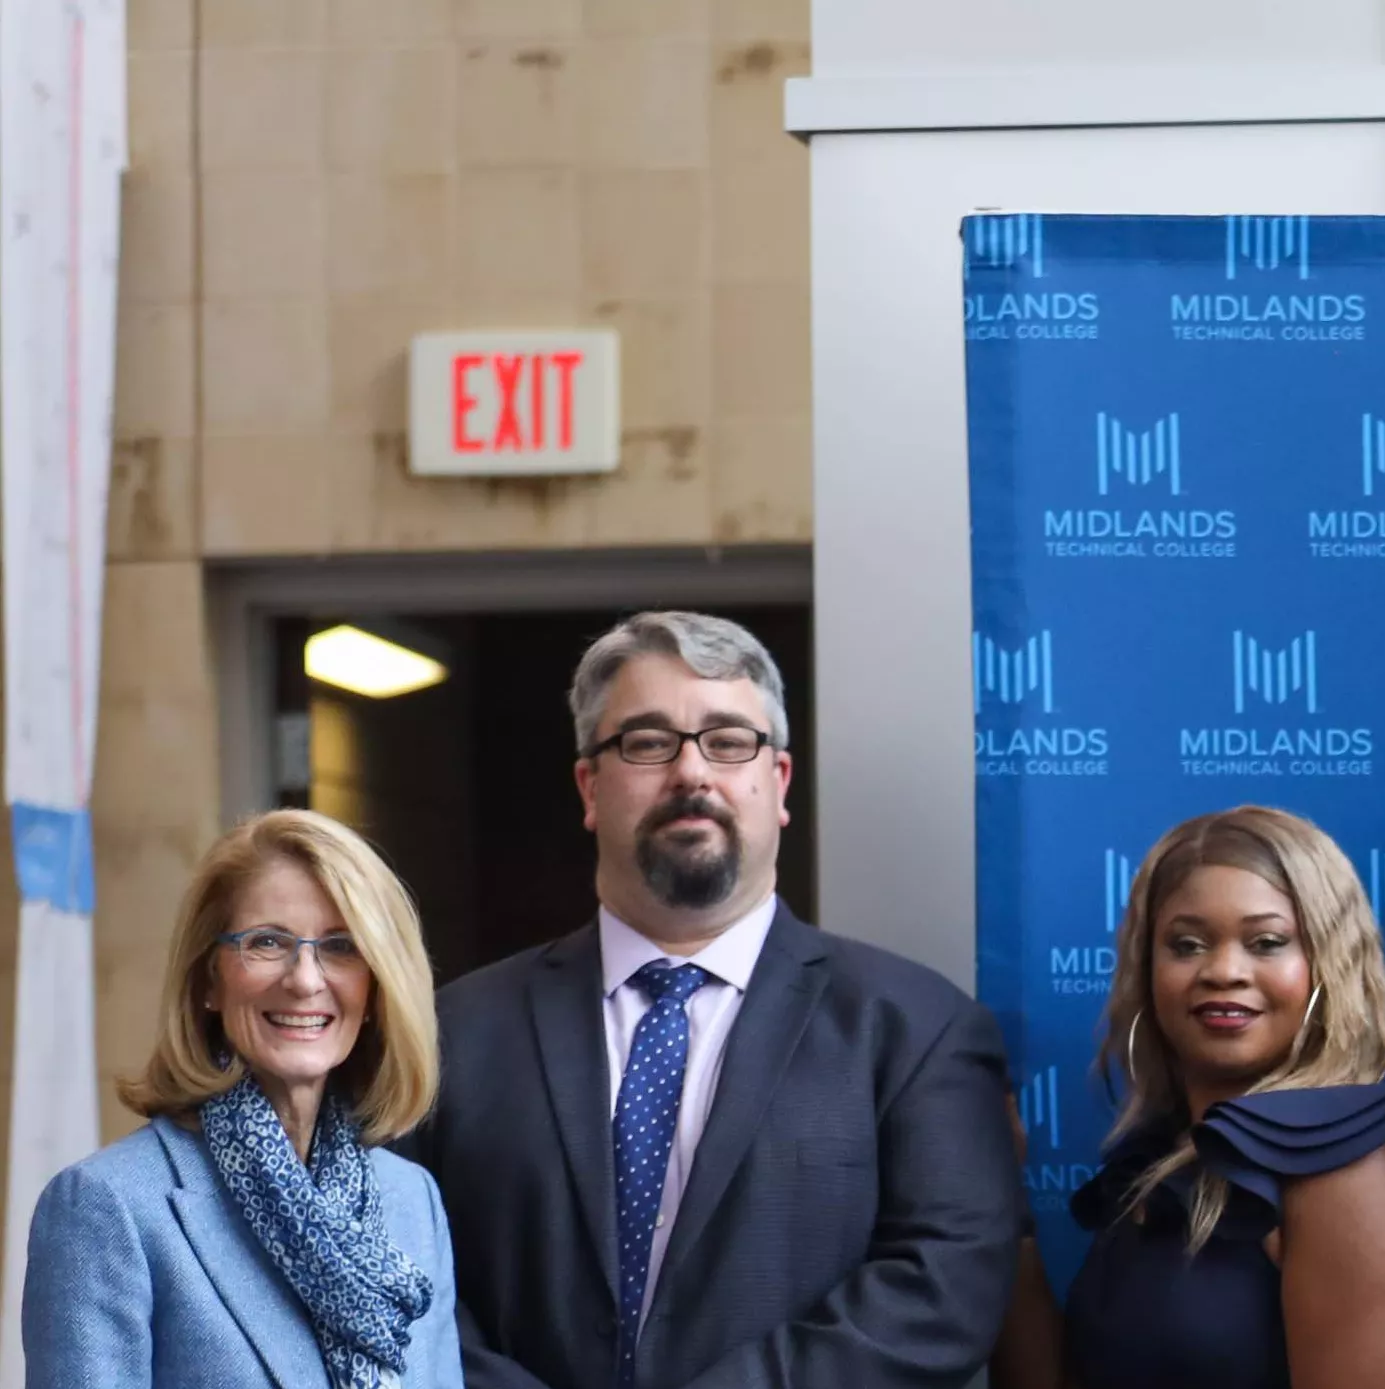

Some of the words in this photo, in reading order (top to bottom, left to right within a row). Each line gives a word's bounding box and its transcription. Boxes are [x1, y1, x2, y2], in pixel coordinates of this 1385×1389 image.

[1170, 293, 1366, 322] MIDLANDS
[1015, 323, 1098, 340] COLLEGE
[1171, 325, 1275, 341] TECHNICAL
[1280, 325, 1365, 341] COLLEGE
[452, 351, 583, 454] EXIT
[1044, 509, 1237, 539] MIDLANDS
[1044, 541, 1146, 557] TECHNICAL
[1152, 541, 1236, 558] COLLEGE
[1180, 728, 1373, 756] MIDLANDS
[1025, 759, 1108, 776] COLLEGE
[1180, 759, 1283, 776] TECHNICAL
[1288, 759, 1373, 776] COLLEGE
